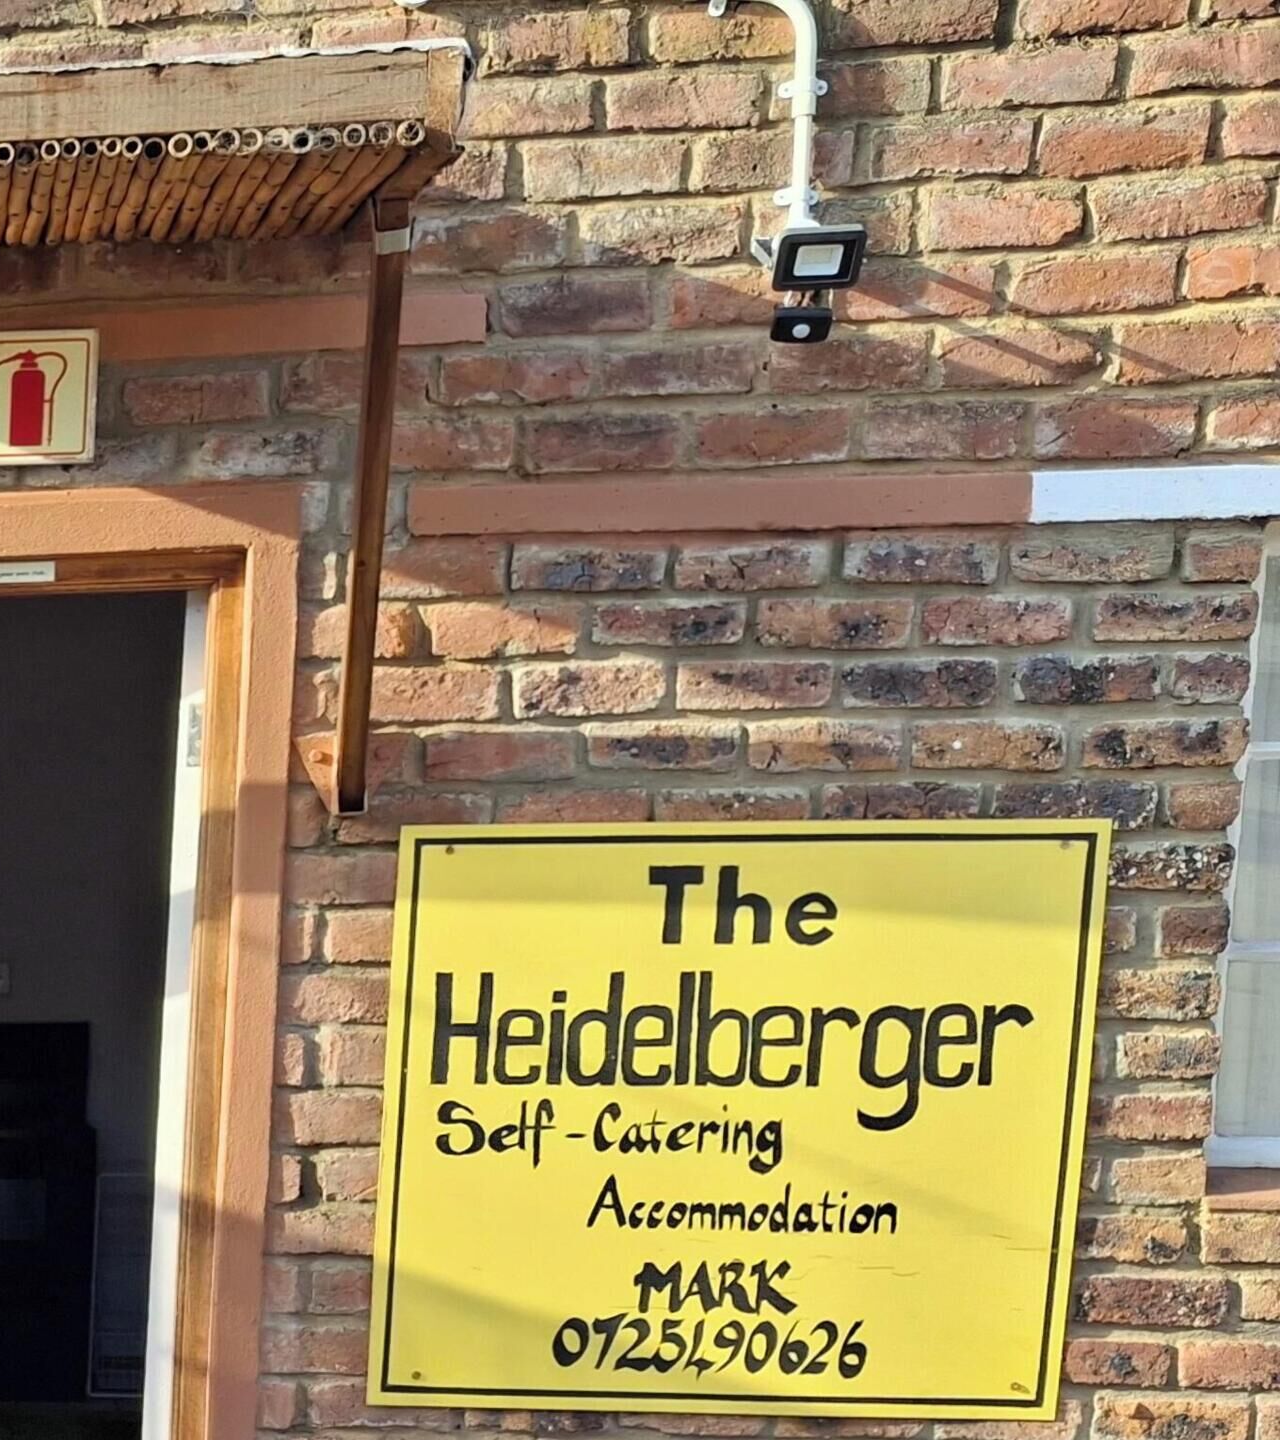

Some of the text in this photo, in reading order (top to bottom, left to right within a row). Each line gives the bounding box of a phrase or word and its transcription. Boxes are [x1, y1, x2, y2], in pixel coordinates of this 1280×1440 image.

[648, 865, 839, 946] The
[429, 970, 1035, 1132] Heidelberger
[586, 1174, 898, 1235] Accommodation
[633, 1259, 799, 1315] MARK
